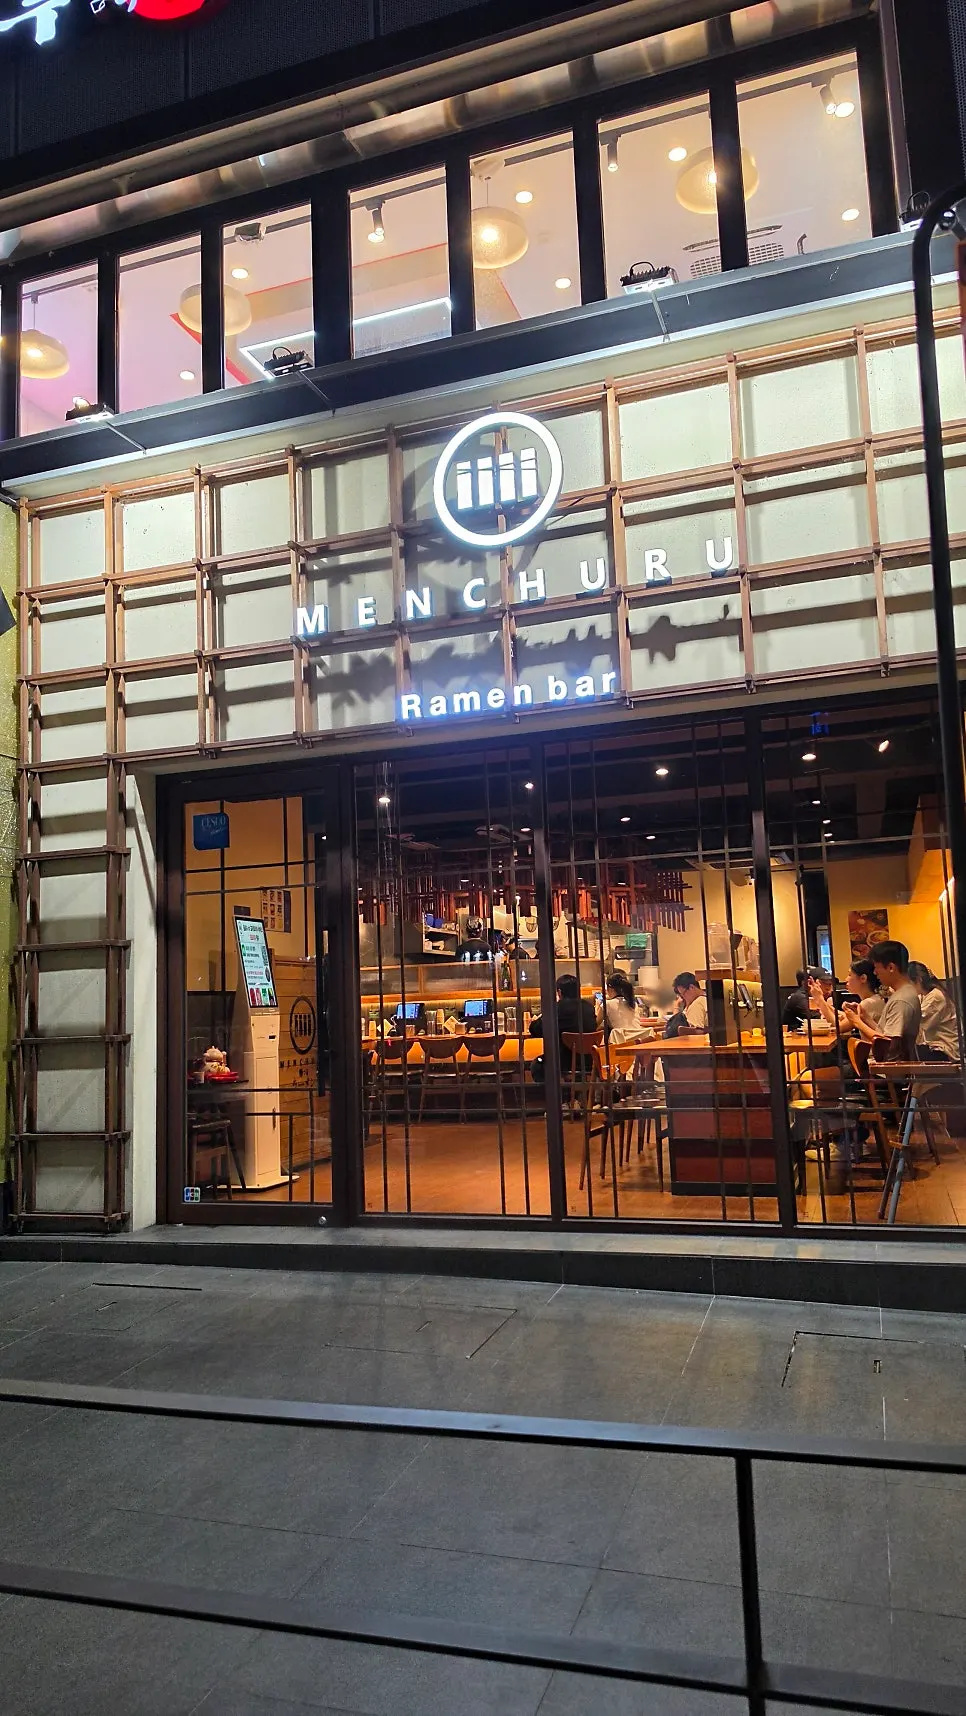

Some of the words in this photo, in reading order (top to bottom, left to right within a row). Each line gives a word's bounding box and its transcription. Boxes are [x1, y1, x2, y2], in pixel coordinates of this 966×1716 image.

[296, 536, 735, 637] MENCHURU
[400, 682, 532, 721] Ramen
[548, 669, 617, 703] bar
